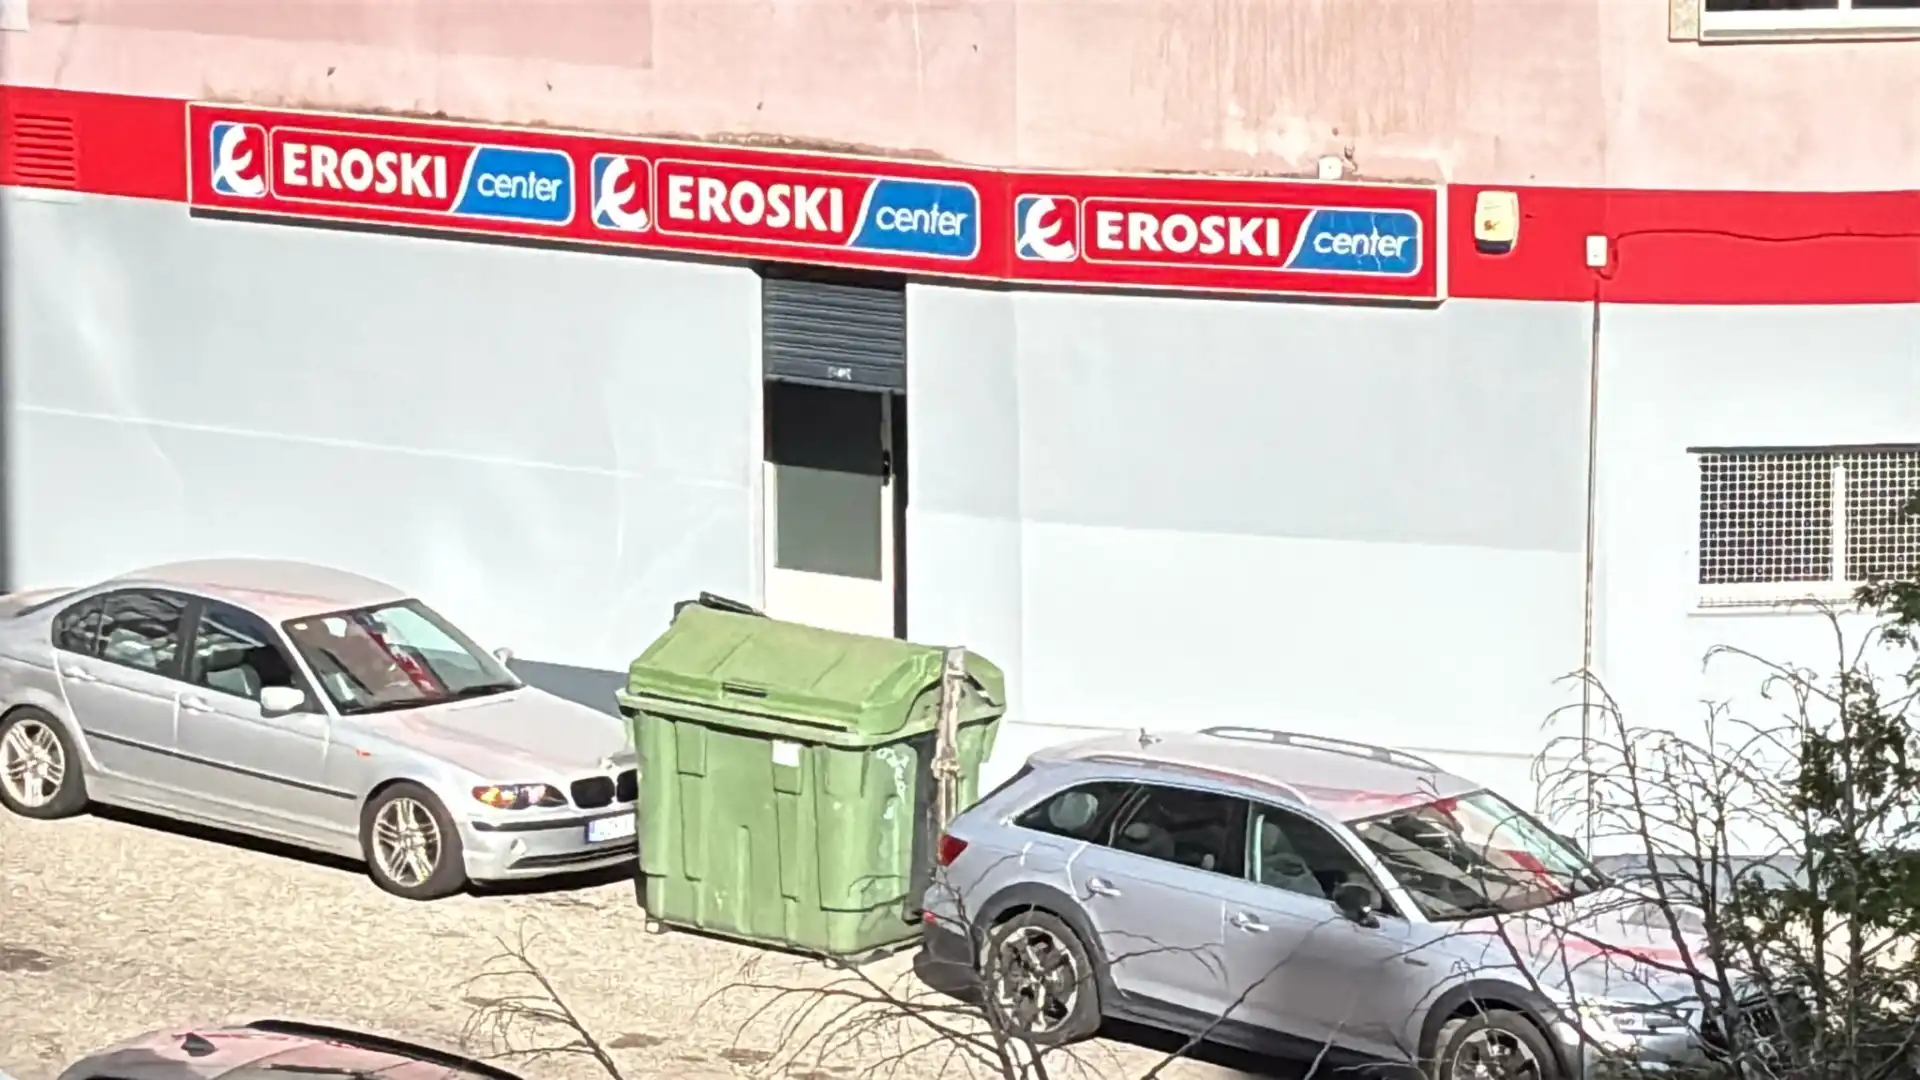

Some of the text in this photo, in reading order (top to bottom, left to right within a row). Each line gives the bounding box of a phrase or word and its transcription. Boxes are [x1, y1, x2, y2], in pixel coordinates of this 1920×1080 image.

[283, 143, 562, 203] EROSKI center
[668, 175, 968, 237] EROSKI center
[1096, 211, 1409, 257] EROSKI center
